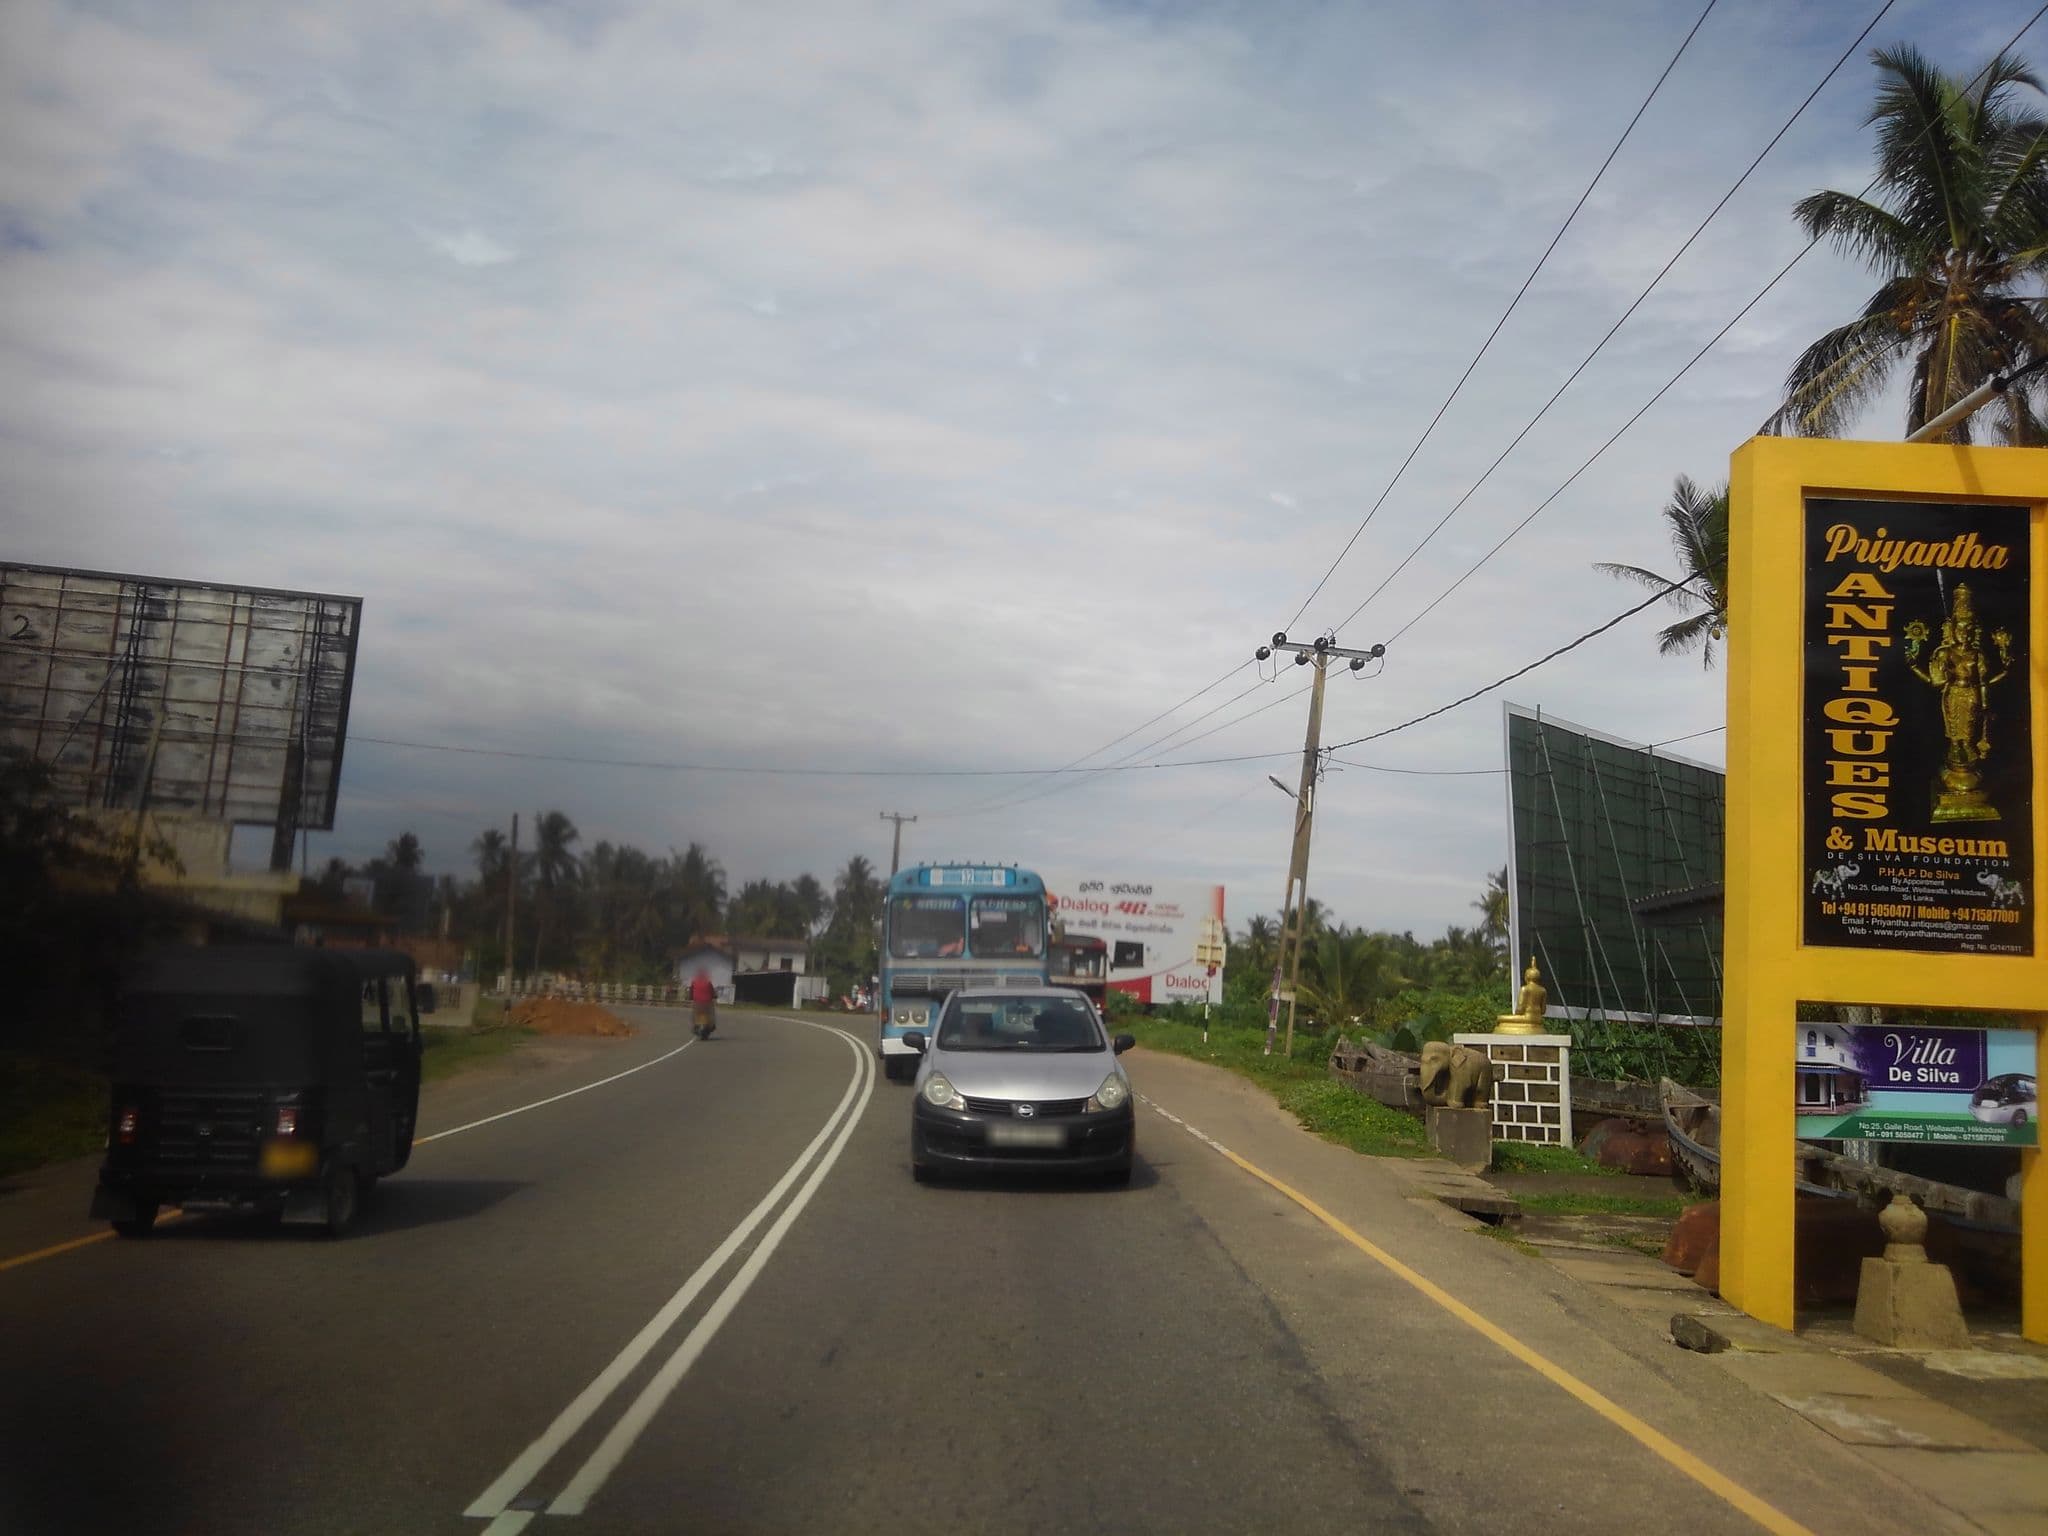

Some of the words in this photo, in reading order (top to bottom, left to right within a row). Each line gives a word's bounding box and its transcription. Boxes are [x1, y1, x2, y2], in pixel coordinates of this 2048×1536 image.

[1825, 523, 2009, 573] Priyantha
[1823, 572, 1900, 819] ANTIQUES
[1825, 826, 1854, 850] &
[1864, 828, 2009, 857] Museum
[1827, 851, 1844, 860] DE
[1857, 852, 1901, 861] SILVA
[1912, 855, 2010, 868] FOUNDATION
[1920, 869, 1934, 879] De
[1935, 870, 1960, 880] Silva
[1060, 897, 1109, 915] Dialog
[1821, 901, 1836, 915] Tel
[1838, 902, 1857, 916] +94
[1857, 903, 1869, 916] 91
[1870, 904, 1911, 918] 5050477
[1917, 906, 1950, 920] Mobile
[1951, 907, 1970, 921] +94
[1841, 916, 1865, 925] Email
[1848, 926, 1867, 935] Web
[1883, 1033, 1957, 1066] Villa
[1888, 1067, 1913, 1082] De
[1916, 1067, 1960, 1083] Silva
